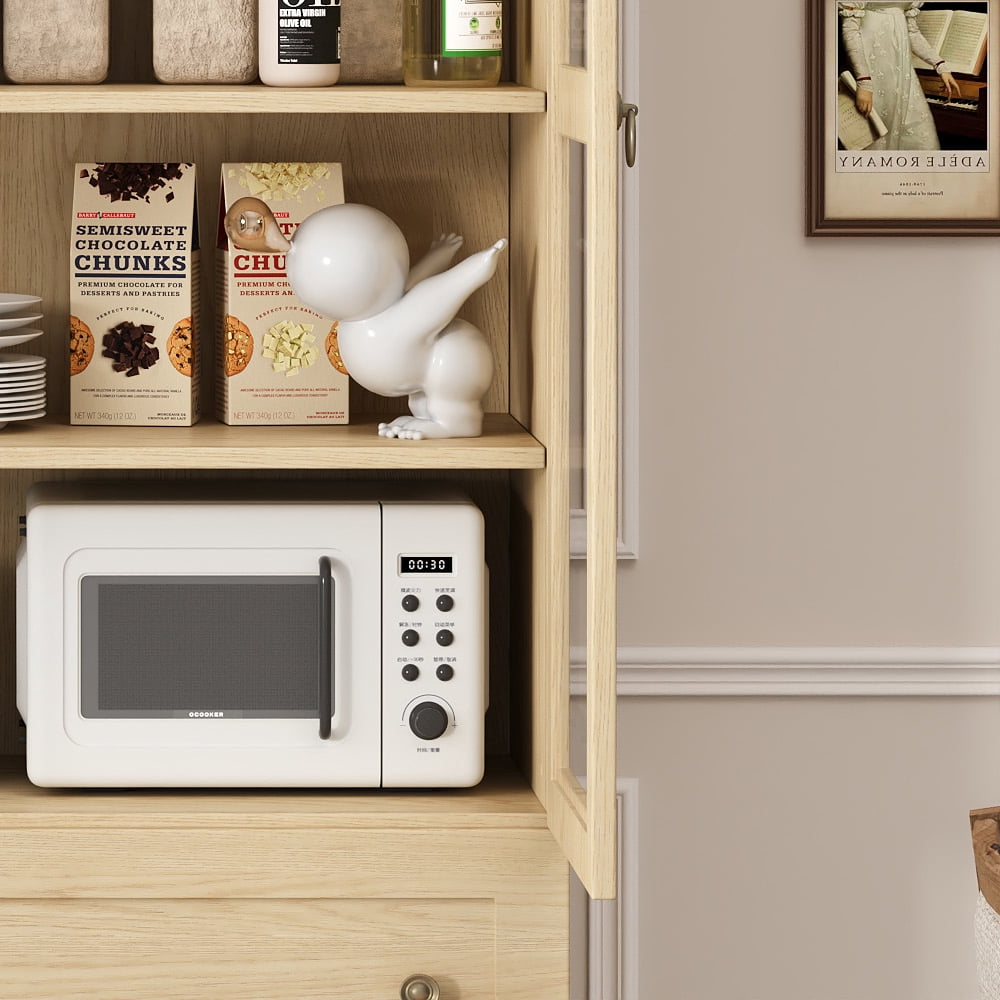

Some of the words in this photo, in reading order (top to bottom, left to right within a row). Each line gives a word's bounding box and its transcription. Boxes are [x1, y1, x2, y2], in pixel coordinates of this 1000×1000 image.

[280, 9, 301, 17] EXTRA
[302, 9, 326, 17] VIRGIN
[280, 19, 299, 28] OLIVE
[300, 19, 312, 28] OIL
[76, 225, 187, 236] SEMISWEET
[75, 240, 186, 250] CHOCOLATE
[74, 254, 186, 271] CHUNKS
[234, 254, 287, 271] CHU
[96, 307, 123, 320] PERFECT
[74, 411, 86, 420] NET
[86, 411, 96, 420] WT
[98, 412, 113, 421] 340g
[233, 411, 244, 420] NET
[246, 411, 256, 420] WT
[257, 412, 272, 421] 340g
[409, 559, 446, 570] 00:30
